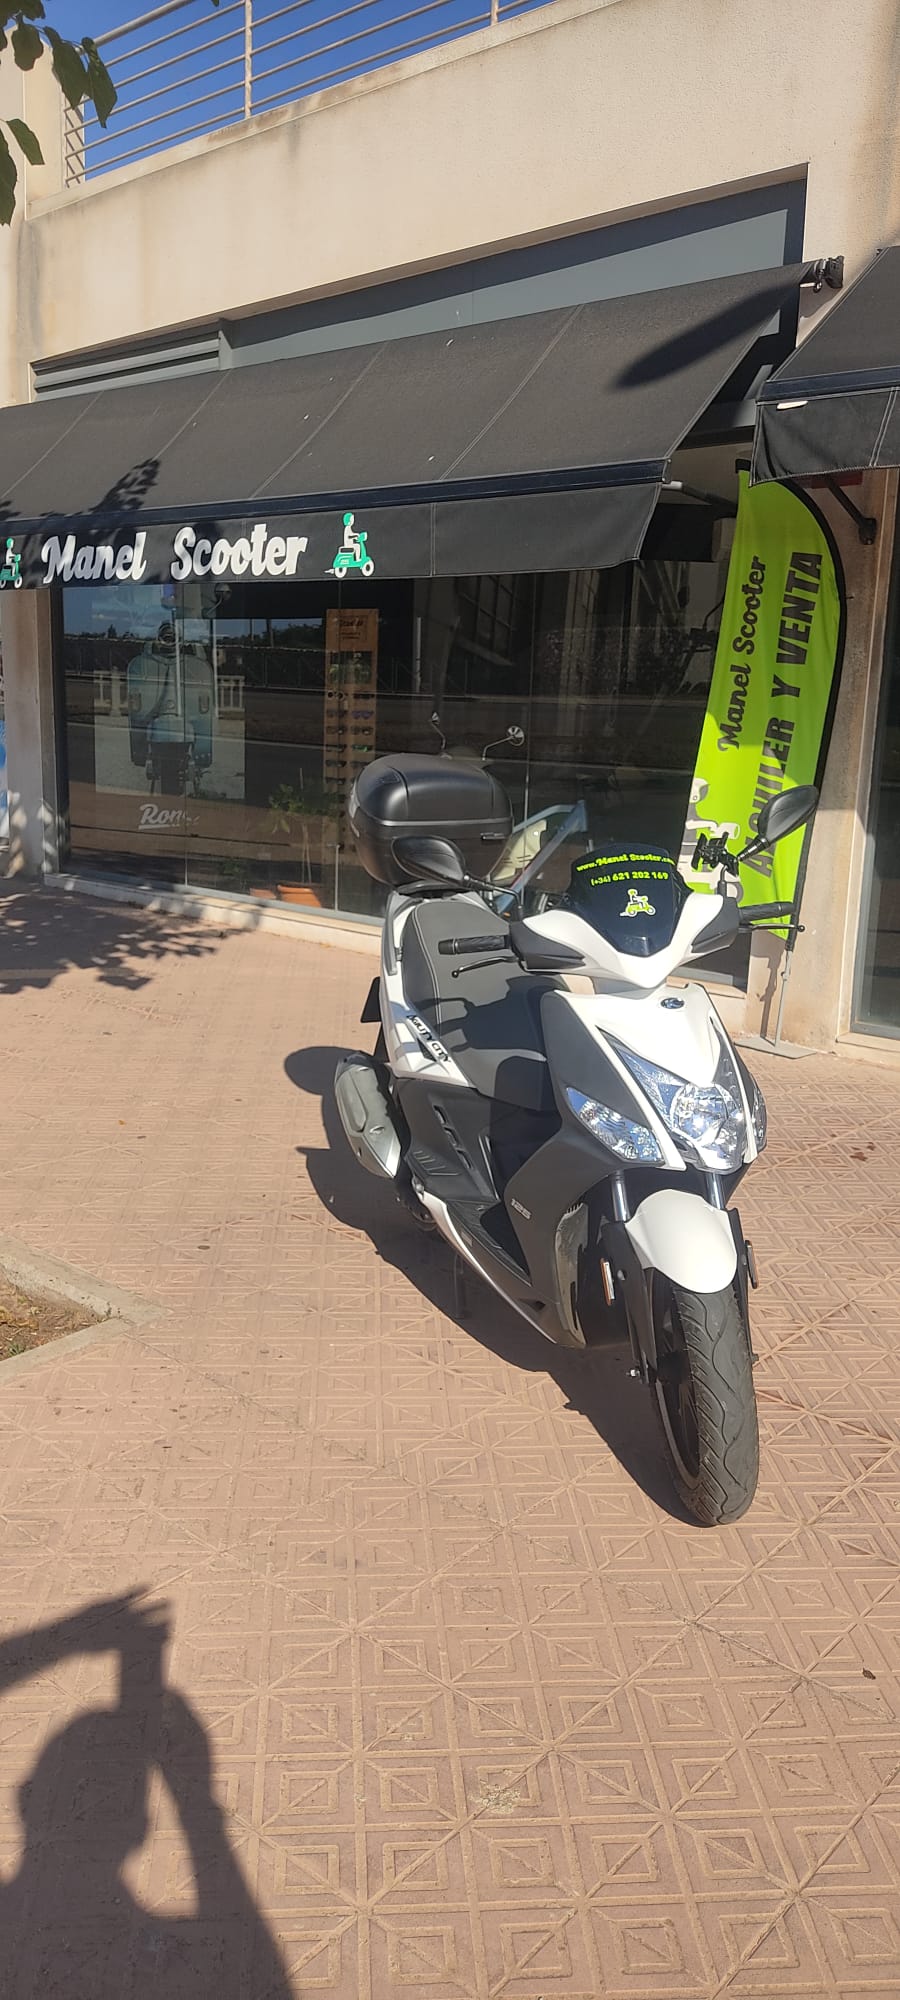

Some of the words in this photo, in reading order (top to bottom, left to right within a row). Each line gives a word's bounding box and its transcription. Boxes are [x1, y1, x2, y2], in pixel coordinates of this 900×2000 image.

[41, 531, 147, 585] Manel
[170, 523, 308, 581] Scooter
[732, 555, 766, 655] Scooter
[776, 552, 823, 664] VENTA
[771, 674, 800, 698] Y
[717, 664, 751, 752] Manel
[591, 876, 611, 886] (+34)
[612, 872, 630, 881] 621
[632, 871, 650, 879] 202
[651, 872, 669, 880] 169
[431, 1042, 451, 1062] CITY
[511, 1198, 531, 1220] 125
